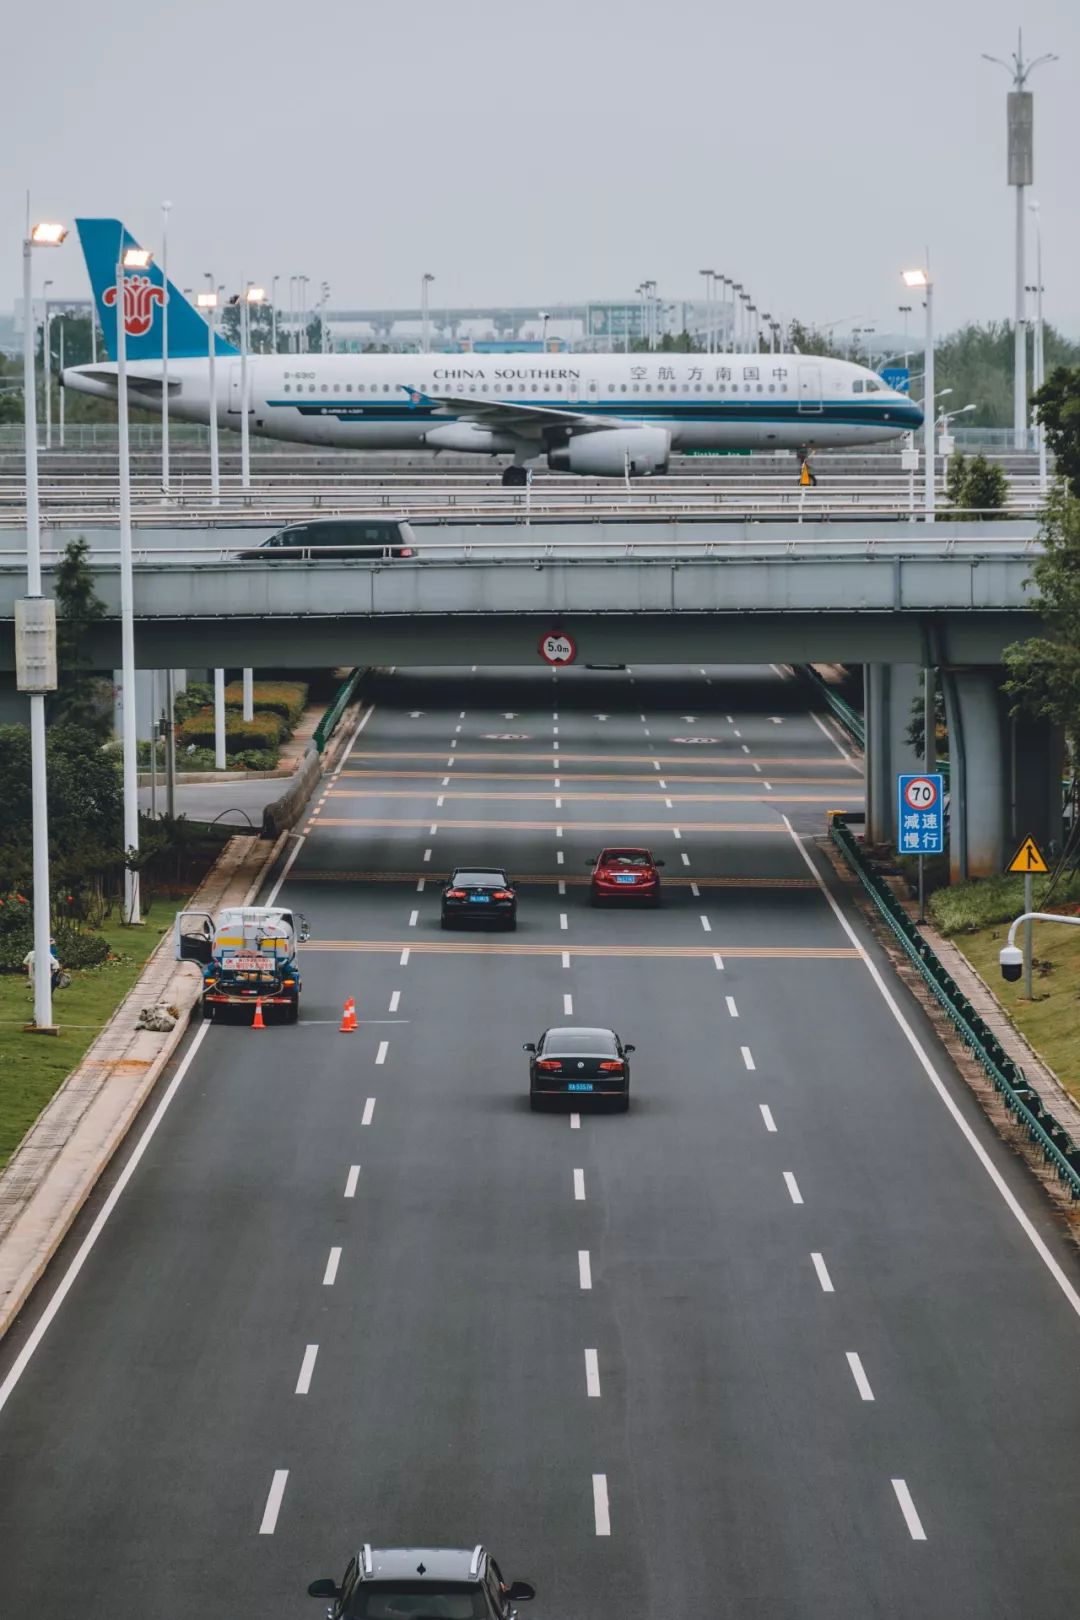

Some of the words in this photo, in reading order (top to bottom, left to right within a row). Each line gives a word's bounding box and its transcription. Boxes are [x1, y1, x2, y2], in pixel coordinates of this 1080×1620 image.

[433, 369, 485, 379] CHINA
[494, 369, 580, 379] SOUTHERN
[547, 641, 569, 653] 5.0m
[912, 787, 931, 801] 70
[904, 813, 938, 829] 减速
[904, 832, 938, 848] 慢行
